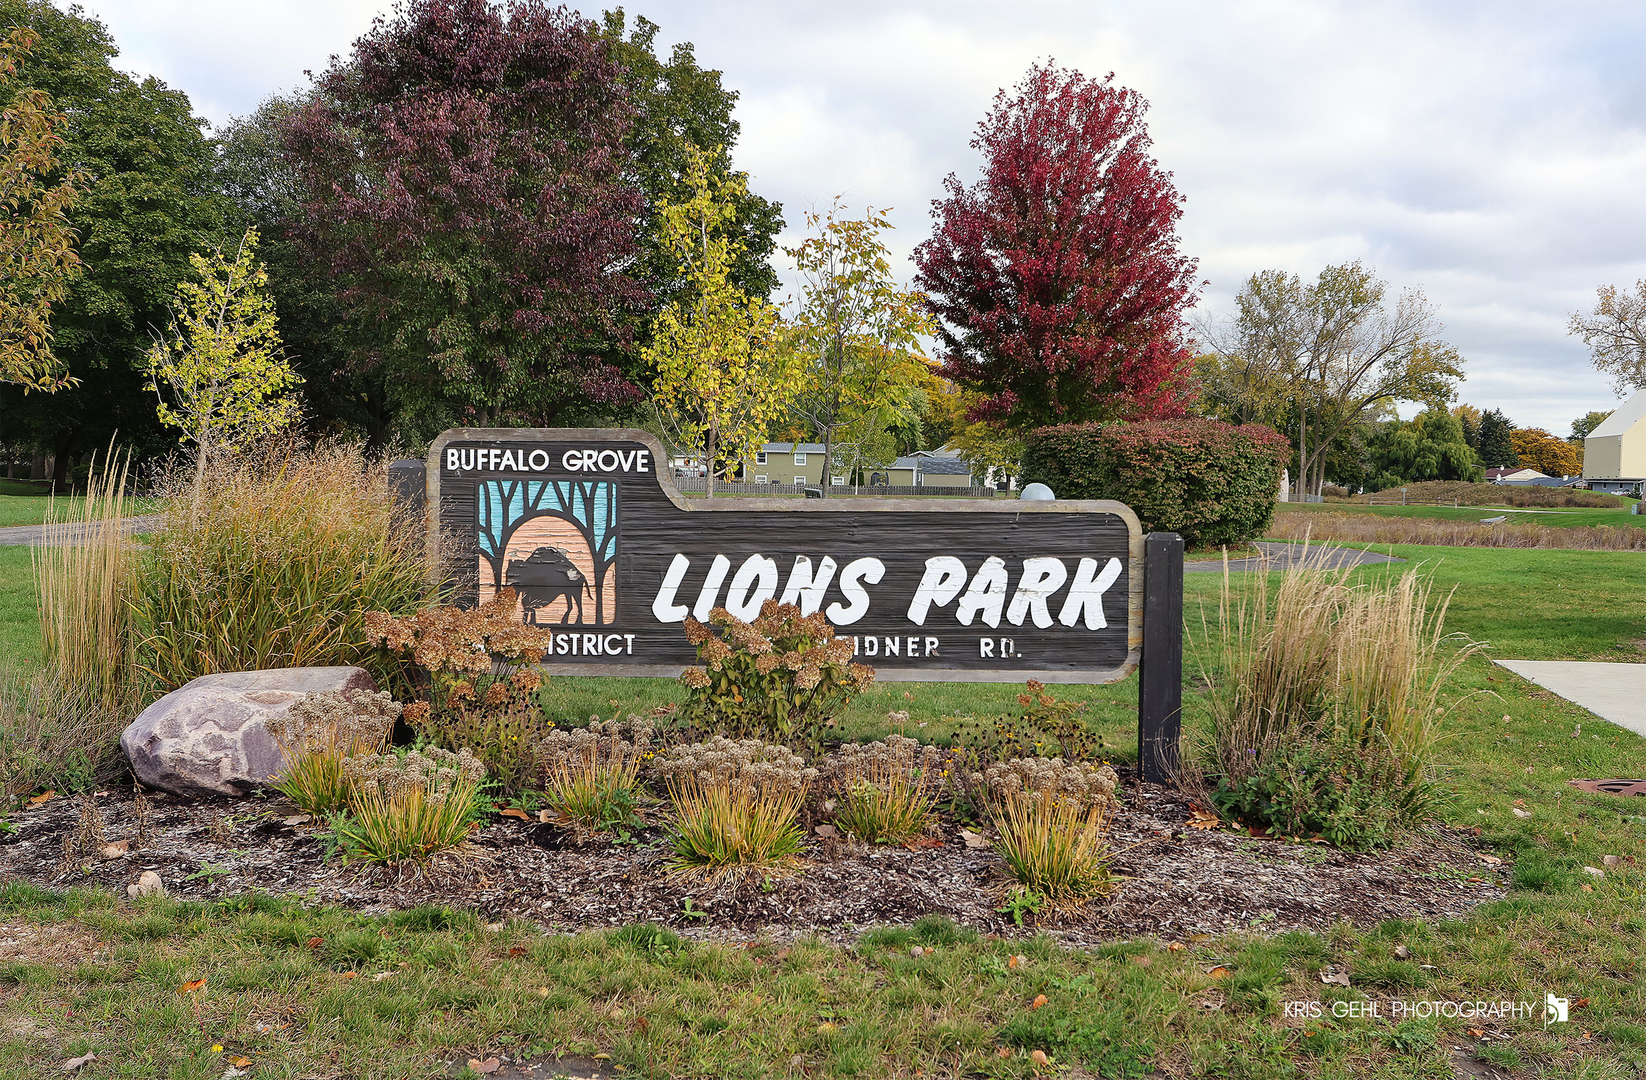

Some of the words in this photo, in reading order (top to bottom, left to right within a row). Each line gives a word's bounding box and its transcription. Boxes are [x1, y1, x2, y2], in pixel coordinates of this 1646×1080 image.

[446, 448, 549, 471] BUFFALO
[562, 450, 649, 472] GROVE
[652, 553, 886, 626] LIONS
[907, 555, 1122, 630] PARK
[548, 633, 635, 655] ISTRICT
[823, 635, 940, 657] IDNER
[980, 637, 1022, 658] RD.
